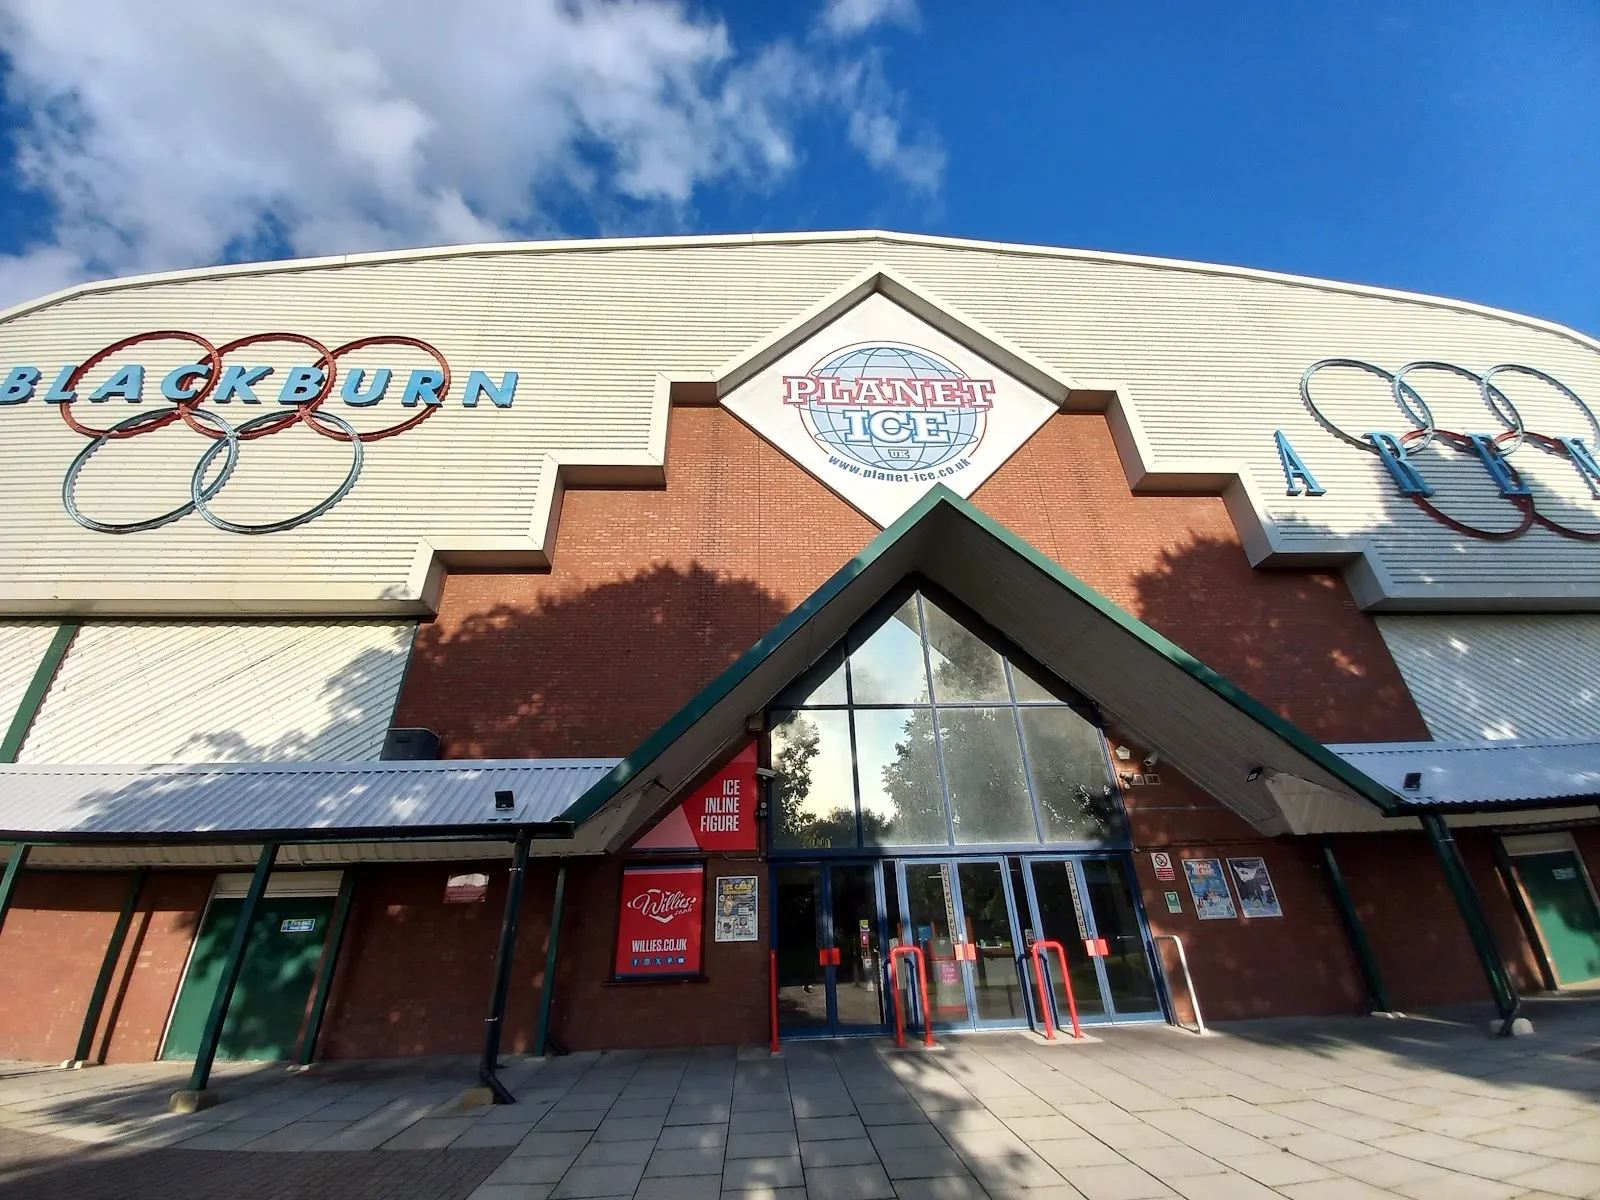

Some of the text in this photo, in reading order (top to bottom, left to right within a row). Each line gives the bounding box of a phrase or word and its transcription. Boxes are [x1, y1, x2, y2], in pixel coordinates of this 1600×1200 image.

[0, 365, 519, 408] BLACKBURN
[782, 375, 996, 409] PLANET
[843, 410, 950, 443] ICE
[888, 449, 910, 459] UK
[828, 454, 971, 482] www.planet-ice.co.uk
[723, 780, 740, 796] ICE
[705, 797, 740, 814] INLINE
[700, 815, 740, 832] FIGURE
[632, 890, 691, 916] Willies
[632, 938, 687, 953] WILLIES.CO.UK
